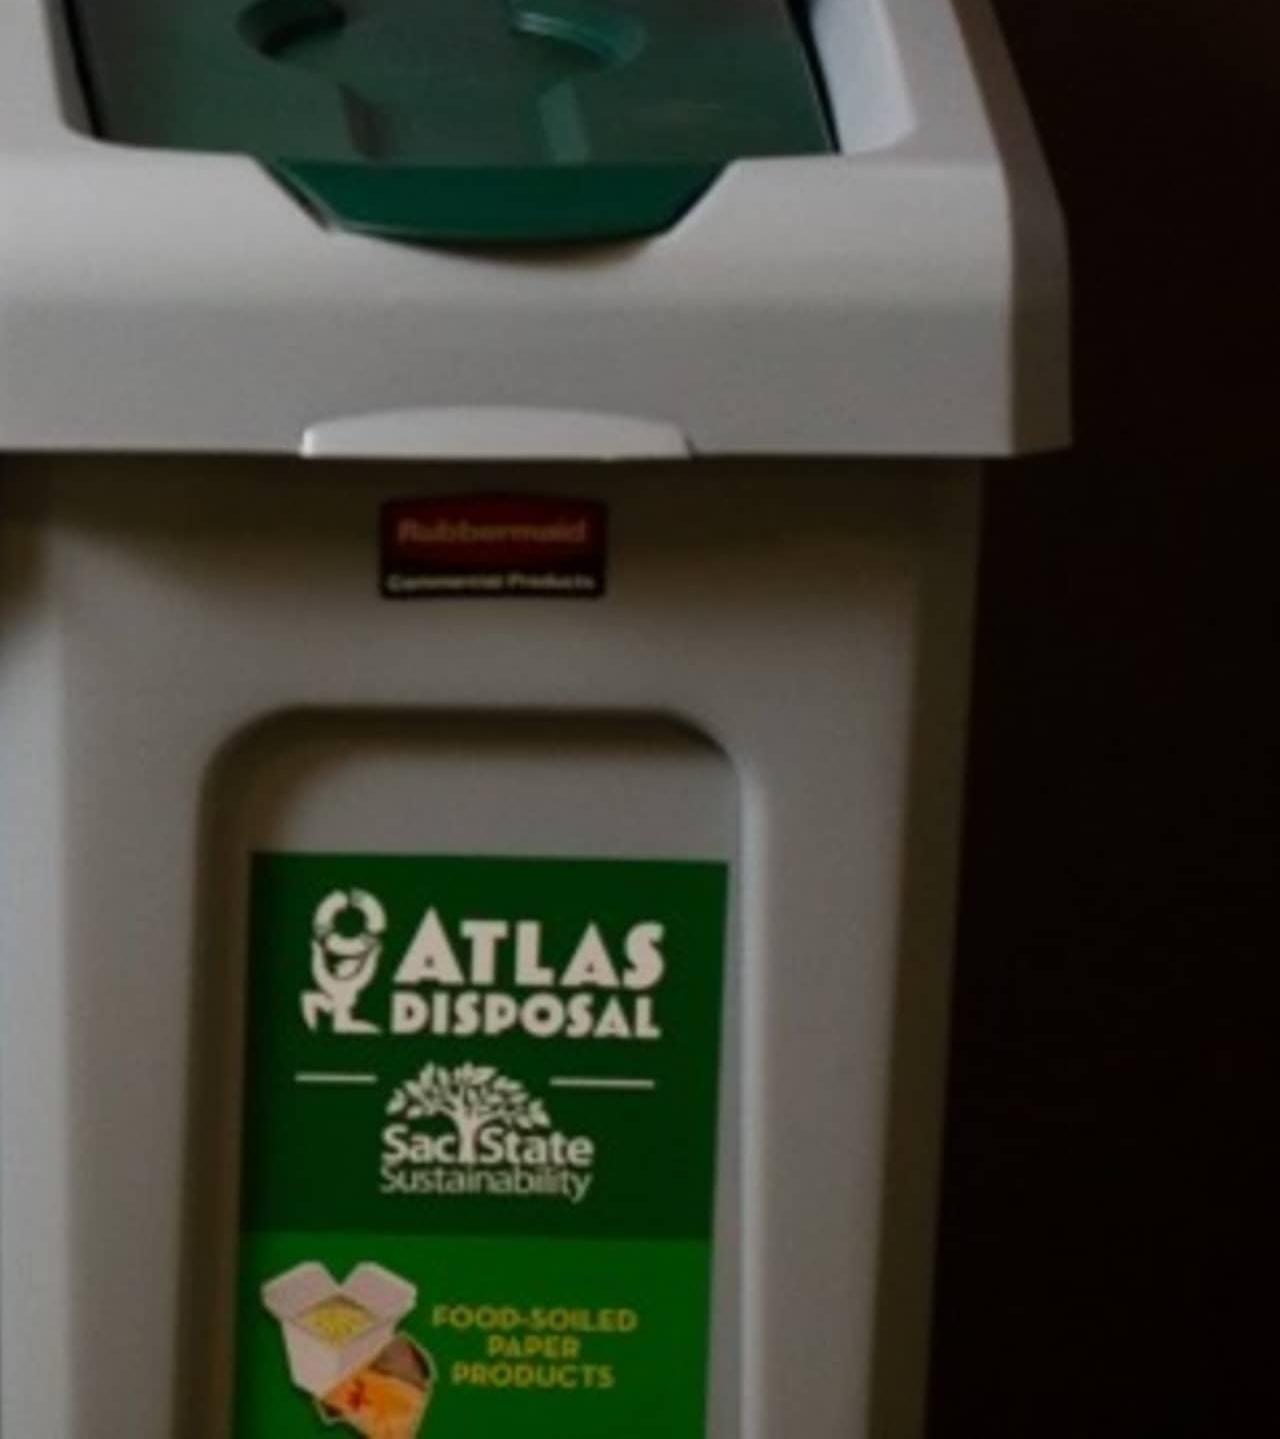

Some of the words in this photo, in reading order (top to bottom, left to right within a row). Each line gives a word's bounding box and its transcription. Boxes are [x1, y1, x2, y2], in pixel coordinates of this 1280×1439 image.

[392, 906, 665, 990] ATLAS
[390, 992, 661, 1039] DISPOSAL
[381, 1124, 453, 1164] Sac
[480, 1127, 595, 1166] State
[380, 1165, 593, 1203] Sustainability
[432, 1306, 638, 1333] FOOD-SOILED
[487, 1335, 581, 1360] PAPER
[452, 1362, 614, 1389] PRODUCTS
